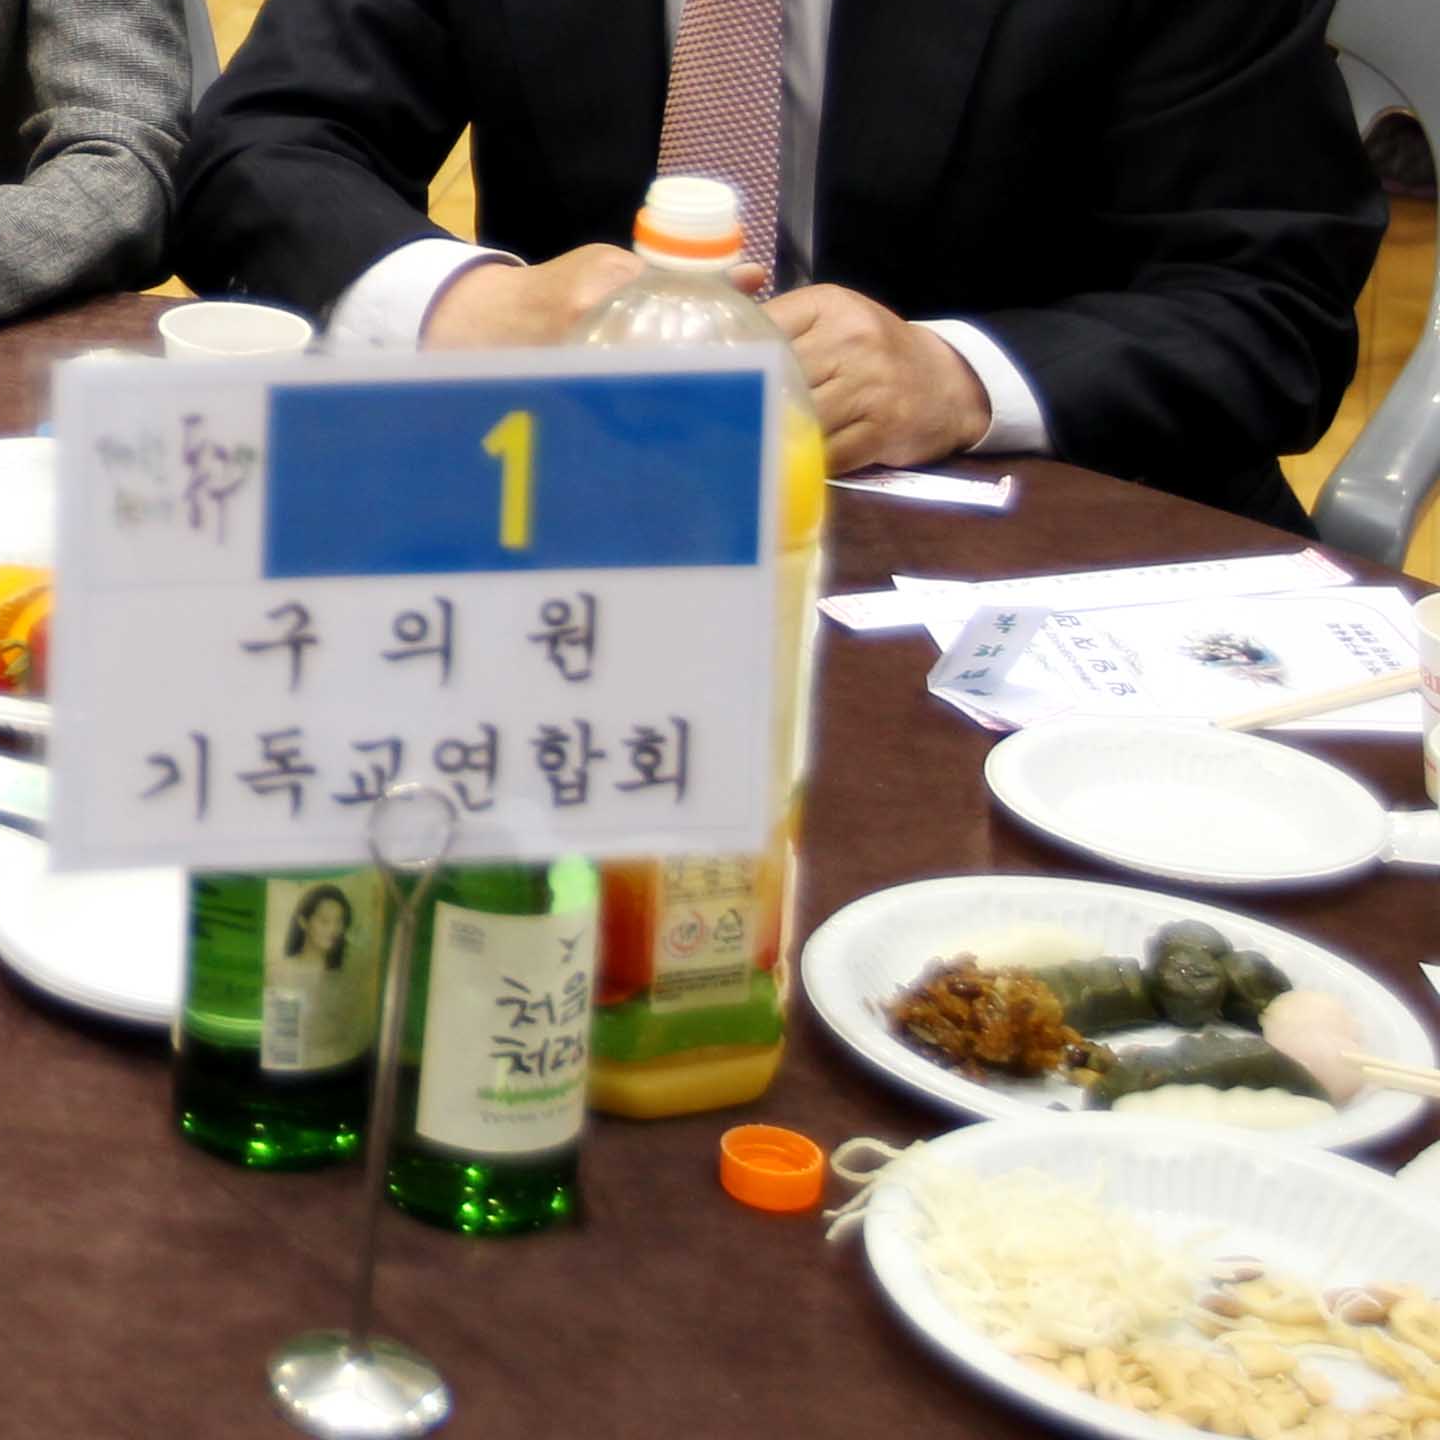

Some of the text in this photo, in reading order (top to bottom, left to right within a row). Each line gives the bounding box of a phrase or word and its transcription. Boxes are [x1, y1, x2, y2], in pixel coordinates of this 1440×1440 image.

[481, 409, 538, 551] 1
[138, 715, 693, 821] 기독교연합회
[496, 972, 589, 1029] 처음
